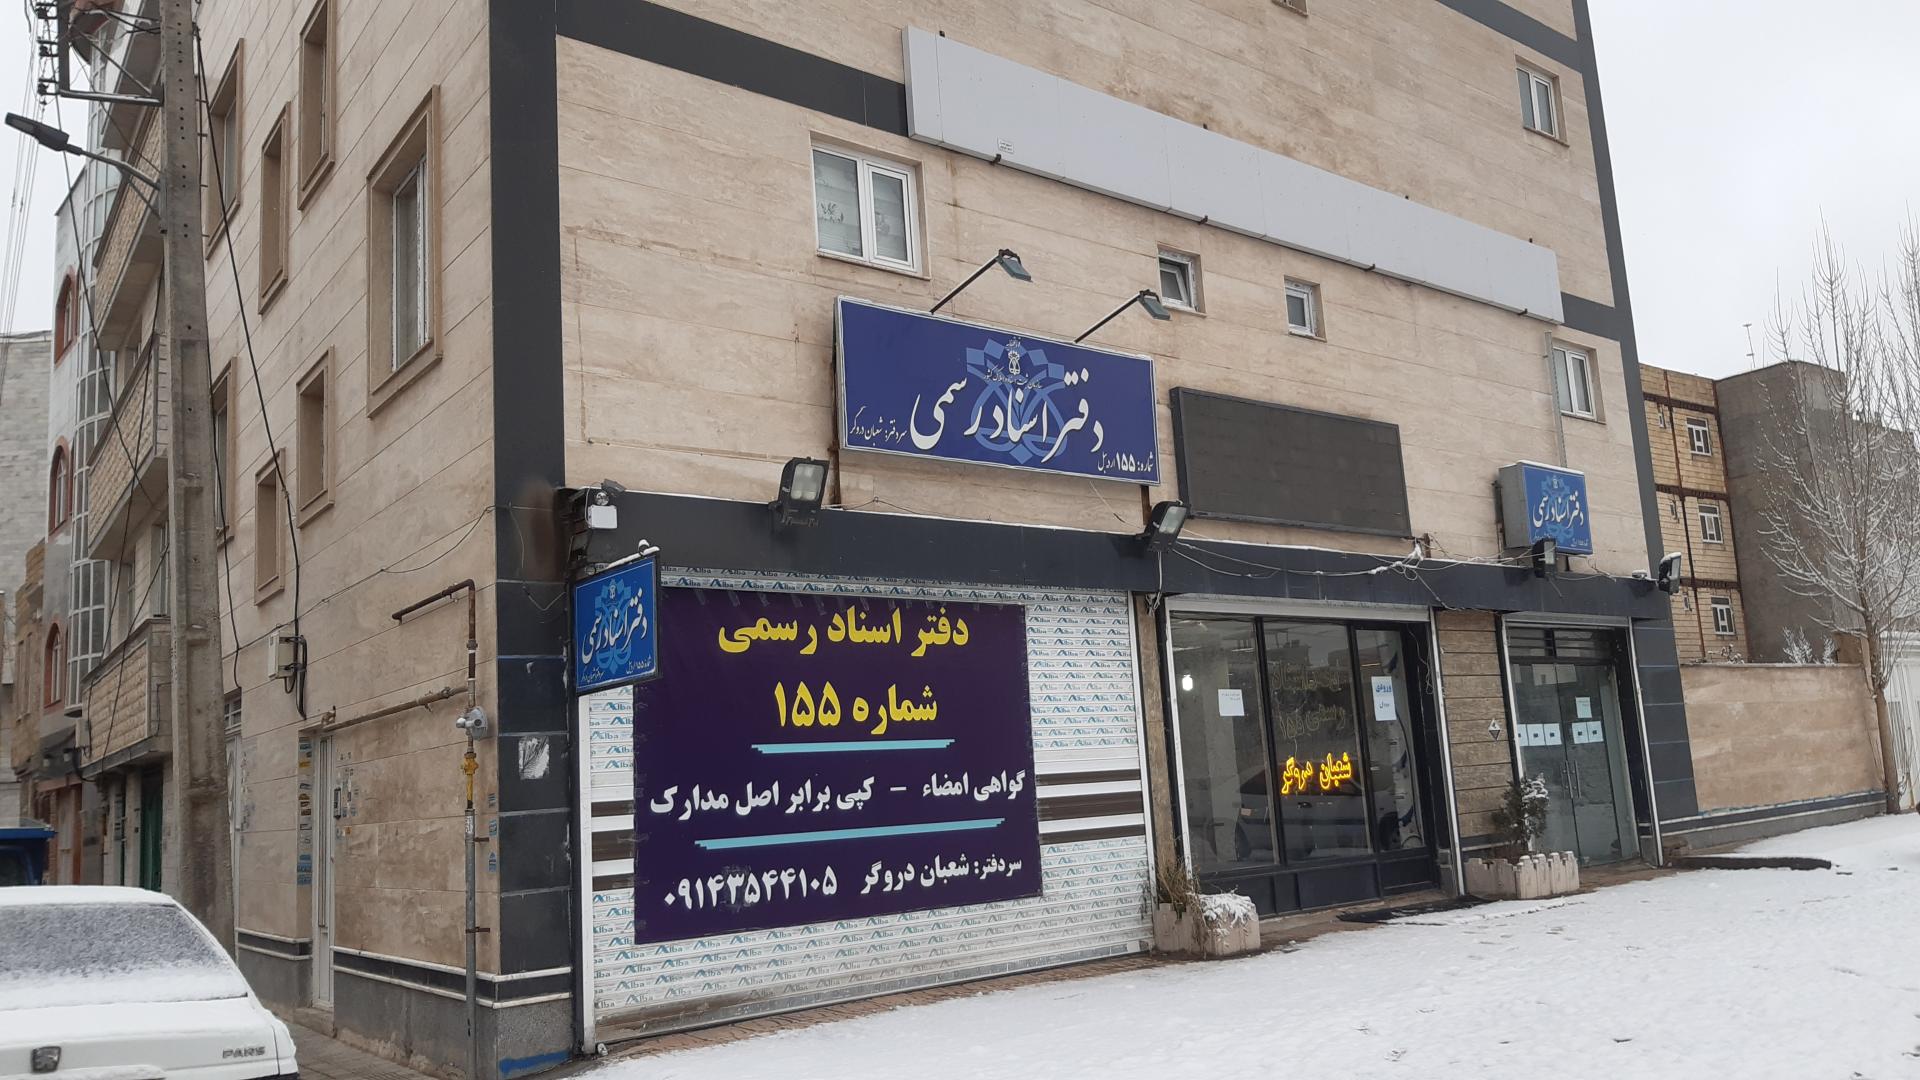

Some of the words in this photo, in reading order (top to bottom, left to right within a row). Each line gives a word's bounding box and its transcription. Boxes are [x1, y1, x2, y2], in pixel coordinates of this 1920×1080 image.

[865, 416, 883, 446] شعبان
[910, 377, 982, 450] رسمی
[990, 386, 1047, 443] اسناد
[1041, 368, 1104, 463] دفتر
[1115, 451, 1136, 473] ۱۵۵
[1532, 494, 1550, 528] رسمی
[1551, 496, 1569, 523] اسناد
[1565, 490, 1584, 529] دفتر
[603, 608, 628, 646] اسناد
[622, 587, 648, 651] دفتر
[718, 617, 818, 655] رسمی
[827, 606, 902, 646] اسناد
[911, 608, 970, 657] دفتر
[581, 613, 603, 665] رسمی
[774, 681, 841, 728] ۱۵۵
[852, 685, 938, 734] شماره
[921, 772, 969, 798] امضاء
[974, 770, 1027, 804] گواهی
[1280, 755, 1314, 796] دروگر
[1319, 751, 1352, 791] شعبان
[650, 786, 729, 821] مدارک
[735, 779, 780, 816] اصل
[785, 779, 830, 815] برابر
[836, 776, 875, 810] کپی
[861, 860, 915, 895] دروگر
[919, 853, 970, 888] شعبان
[974, 854, 1022, 880] سردفتر:
[664, 865, 838, 911] ۰۹۱۴۳۵۴۴۱۰۵
[222, 1046, 265, 1059] PARS
